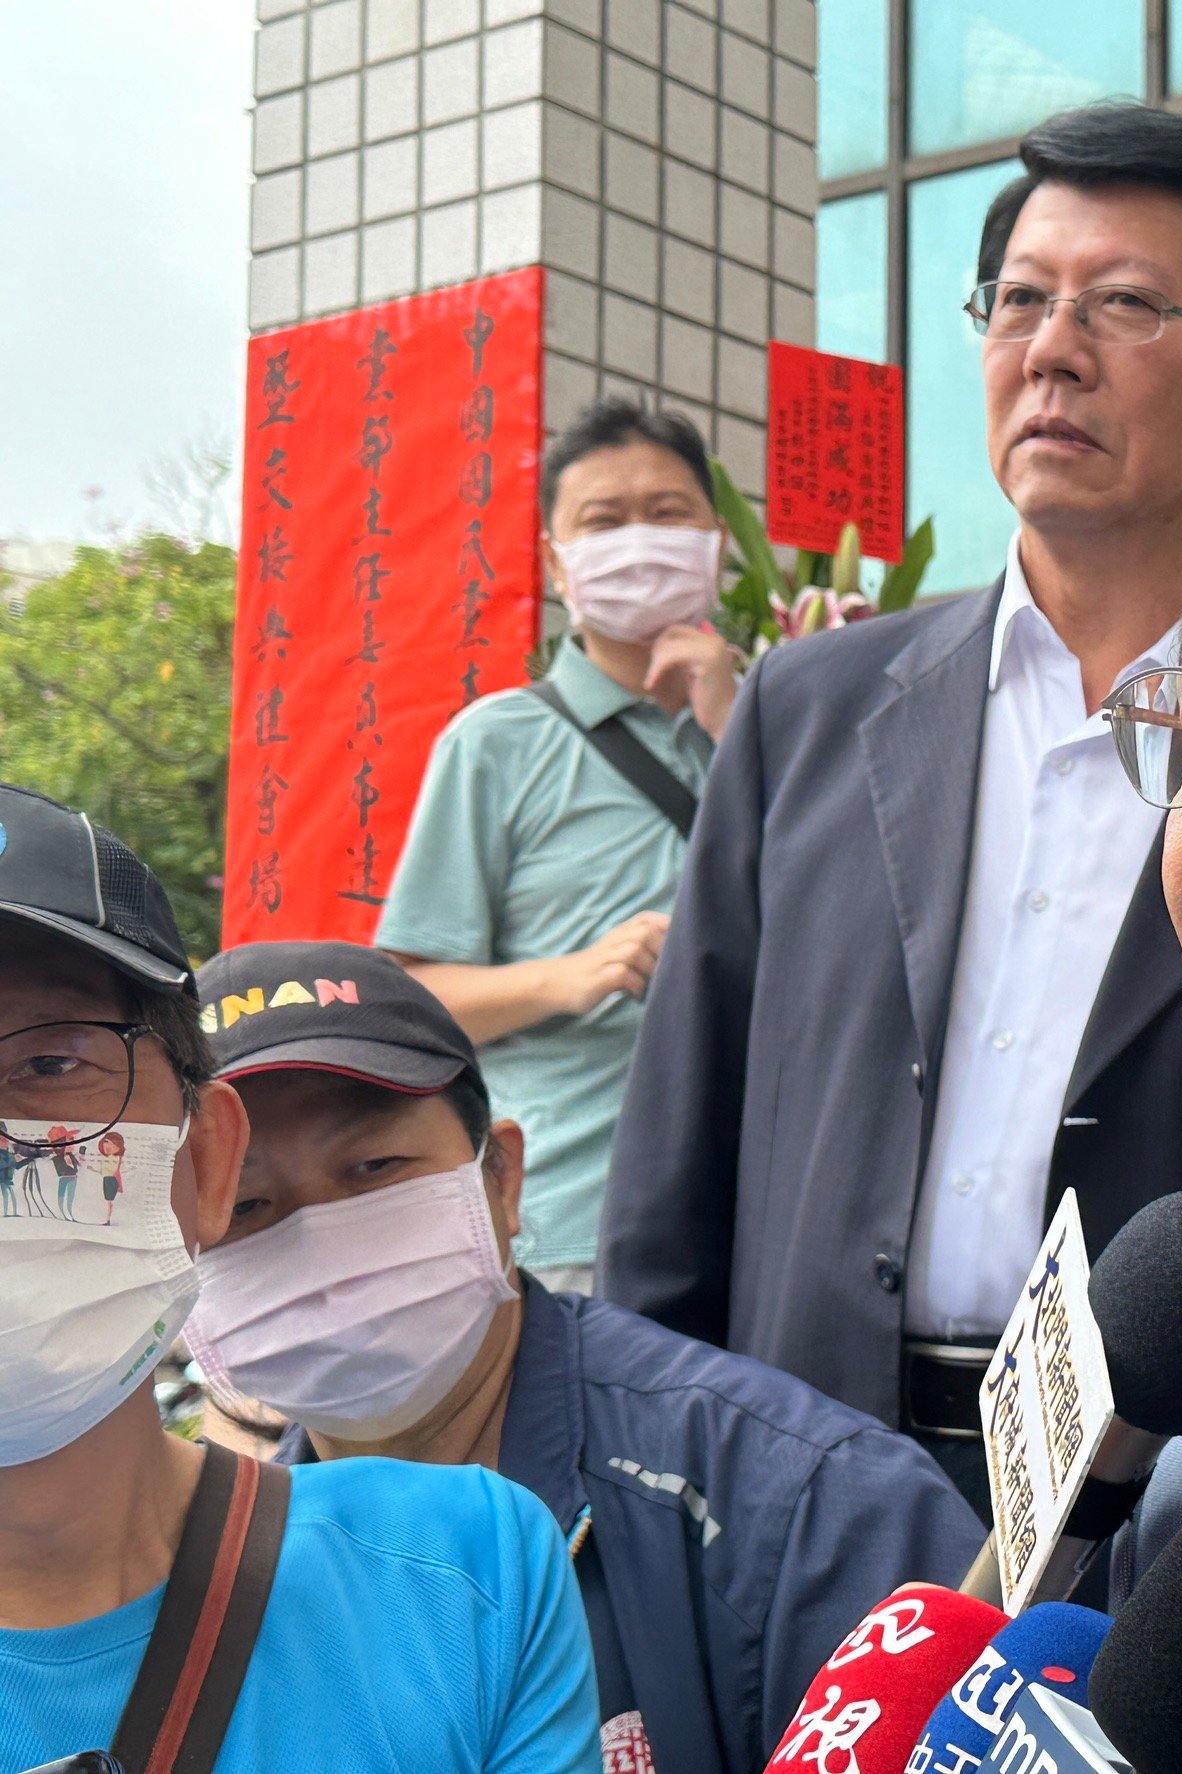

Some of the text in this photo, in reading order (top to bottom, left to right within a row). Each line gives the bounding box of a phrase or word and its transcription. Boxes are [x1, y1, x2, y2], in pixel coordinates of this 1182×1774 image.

[987, 1320, 1036, 1584] 大府城新聞網
[1028, 1224, 1083, 1485] 大北門新聞網
